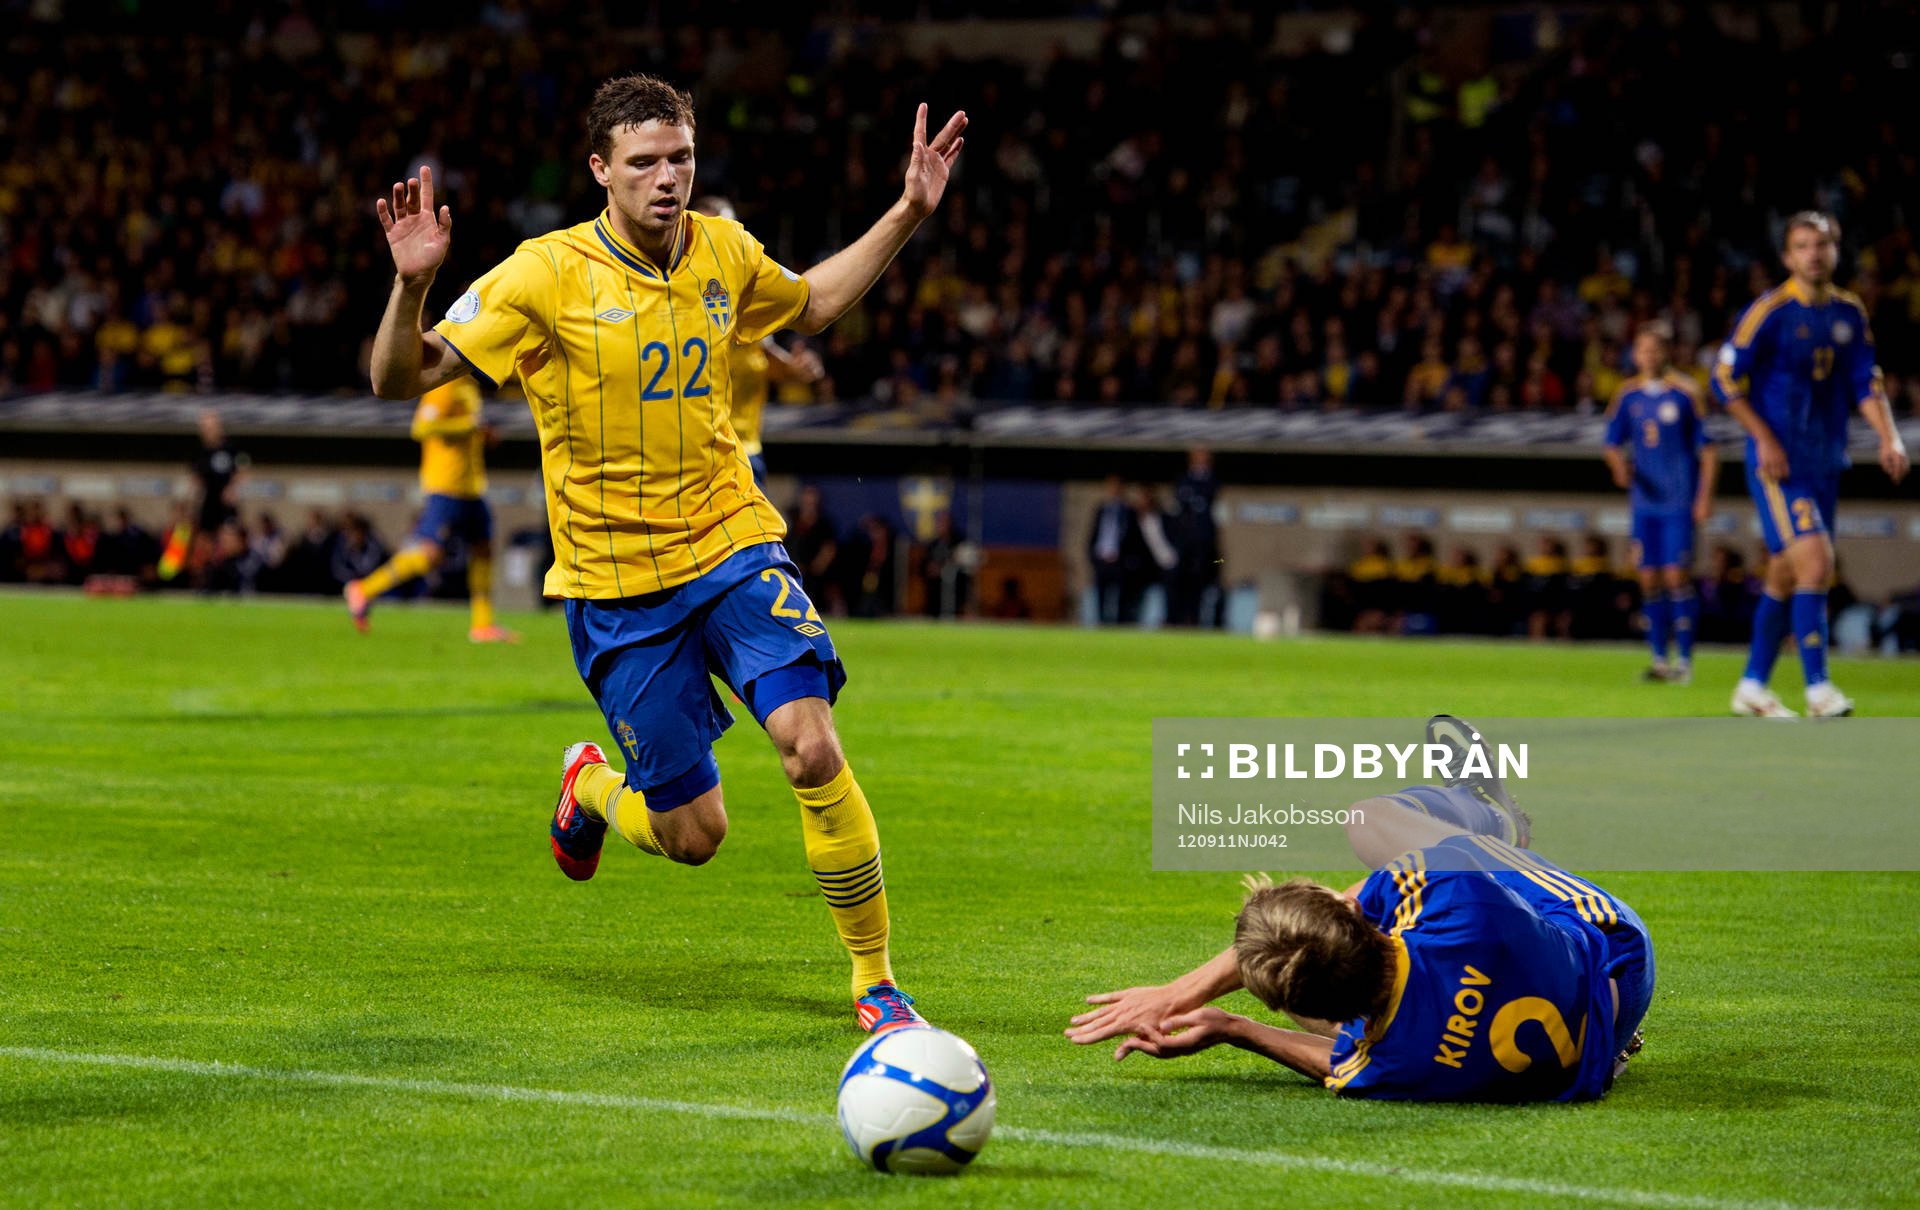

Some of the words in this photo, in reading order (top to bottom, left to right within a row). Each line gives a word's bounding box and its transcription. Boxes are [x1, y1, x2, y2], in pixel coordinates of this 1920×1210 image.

[641, 337, 711, 402] 22
[1433, 964, 1492, 1069] KIROV
[1488, 995, 1588, 1074] 2
